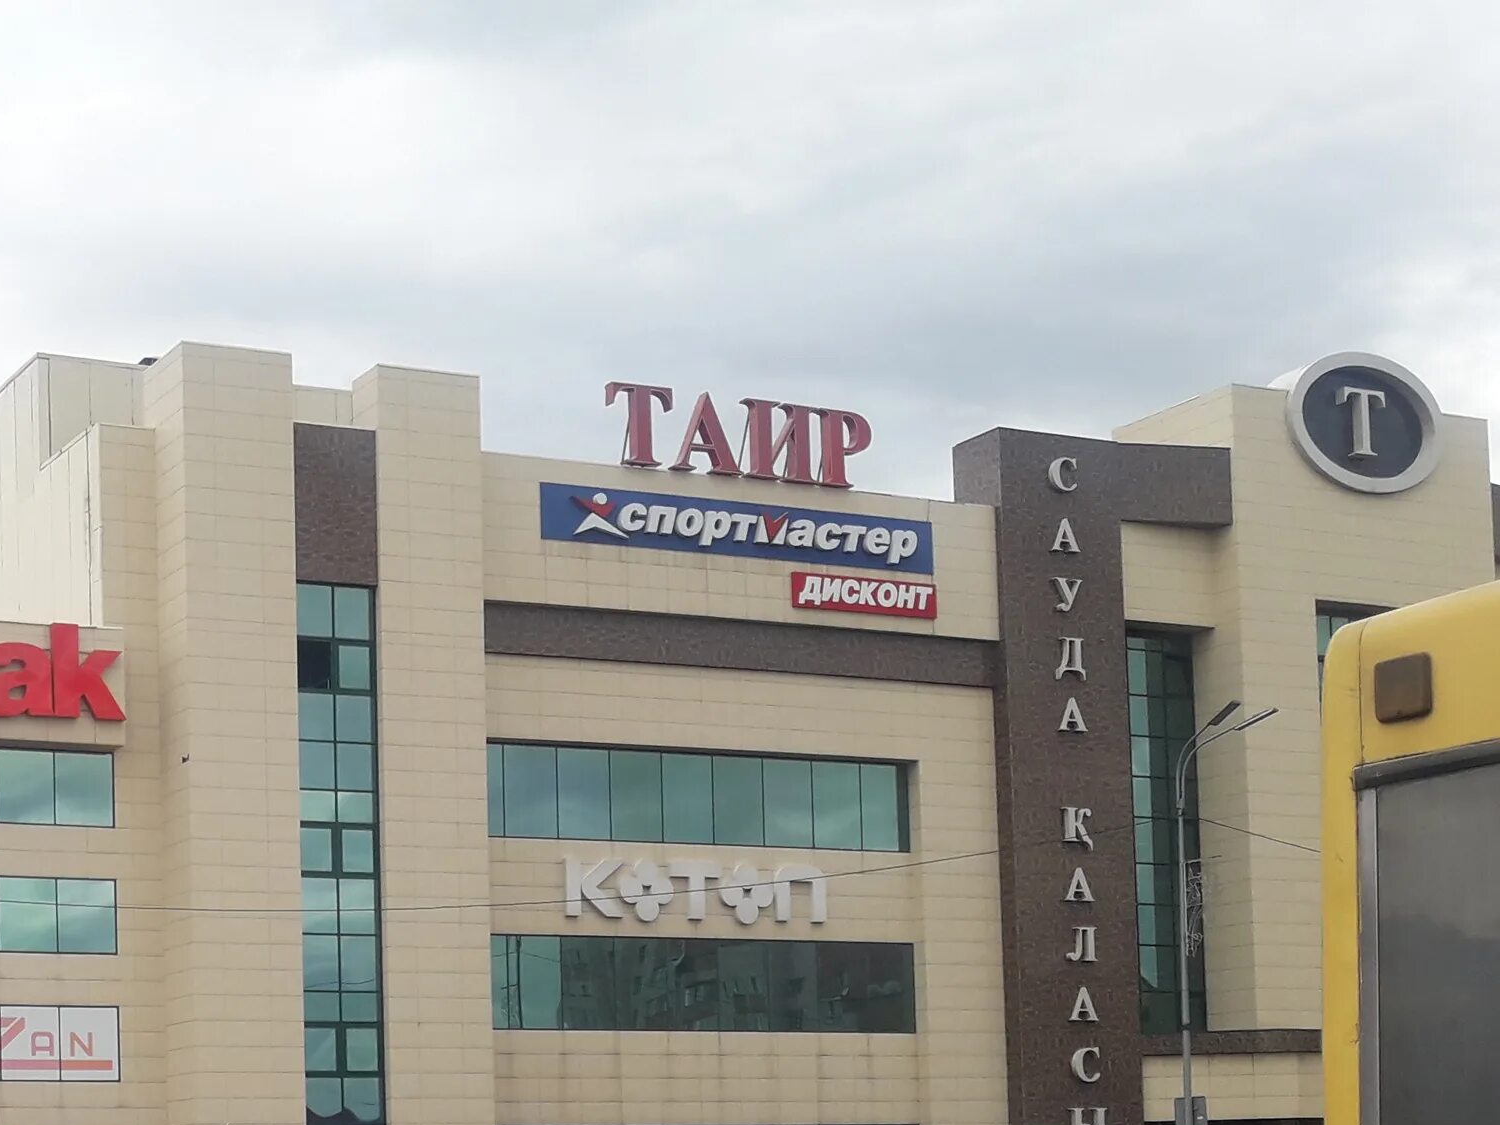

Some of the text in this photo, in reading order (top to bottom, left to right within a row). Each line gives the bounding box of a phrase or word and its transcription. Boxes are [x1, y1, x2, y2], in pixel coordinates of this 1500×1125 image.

[604, 381, 872, 489] ТАИР
[798, 575, 934, 612] ДИСКОНТ
[1047, 456, 1088, 733] САУДА
